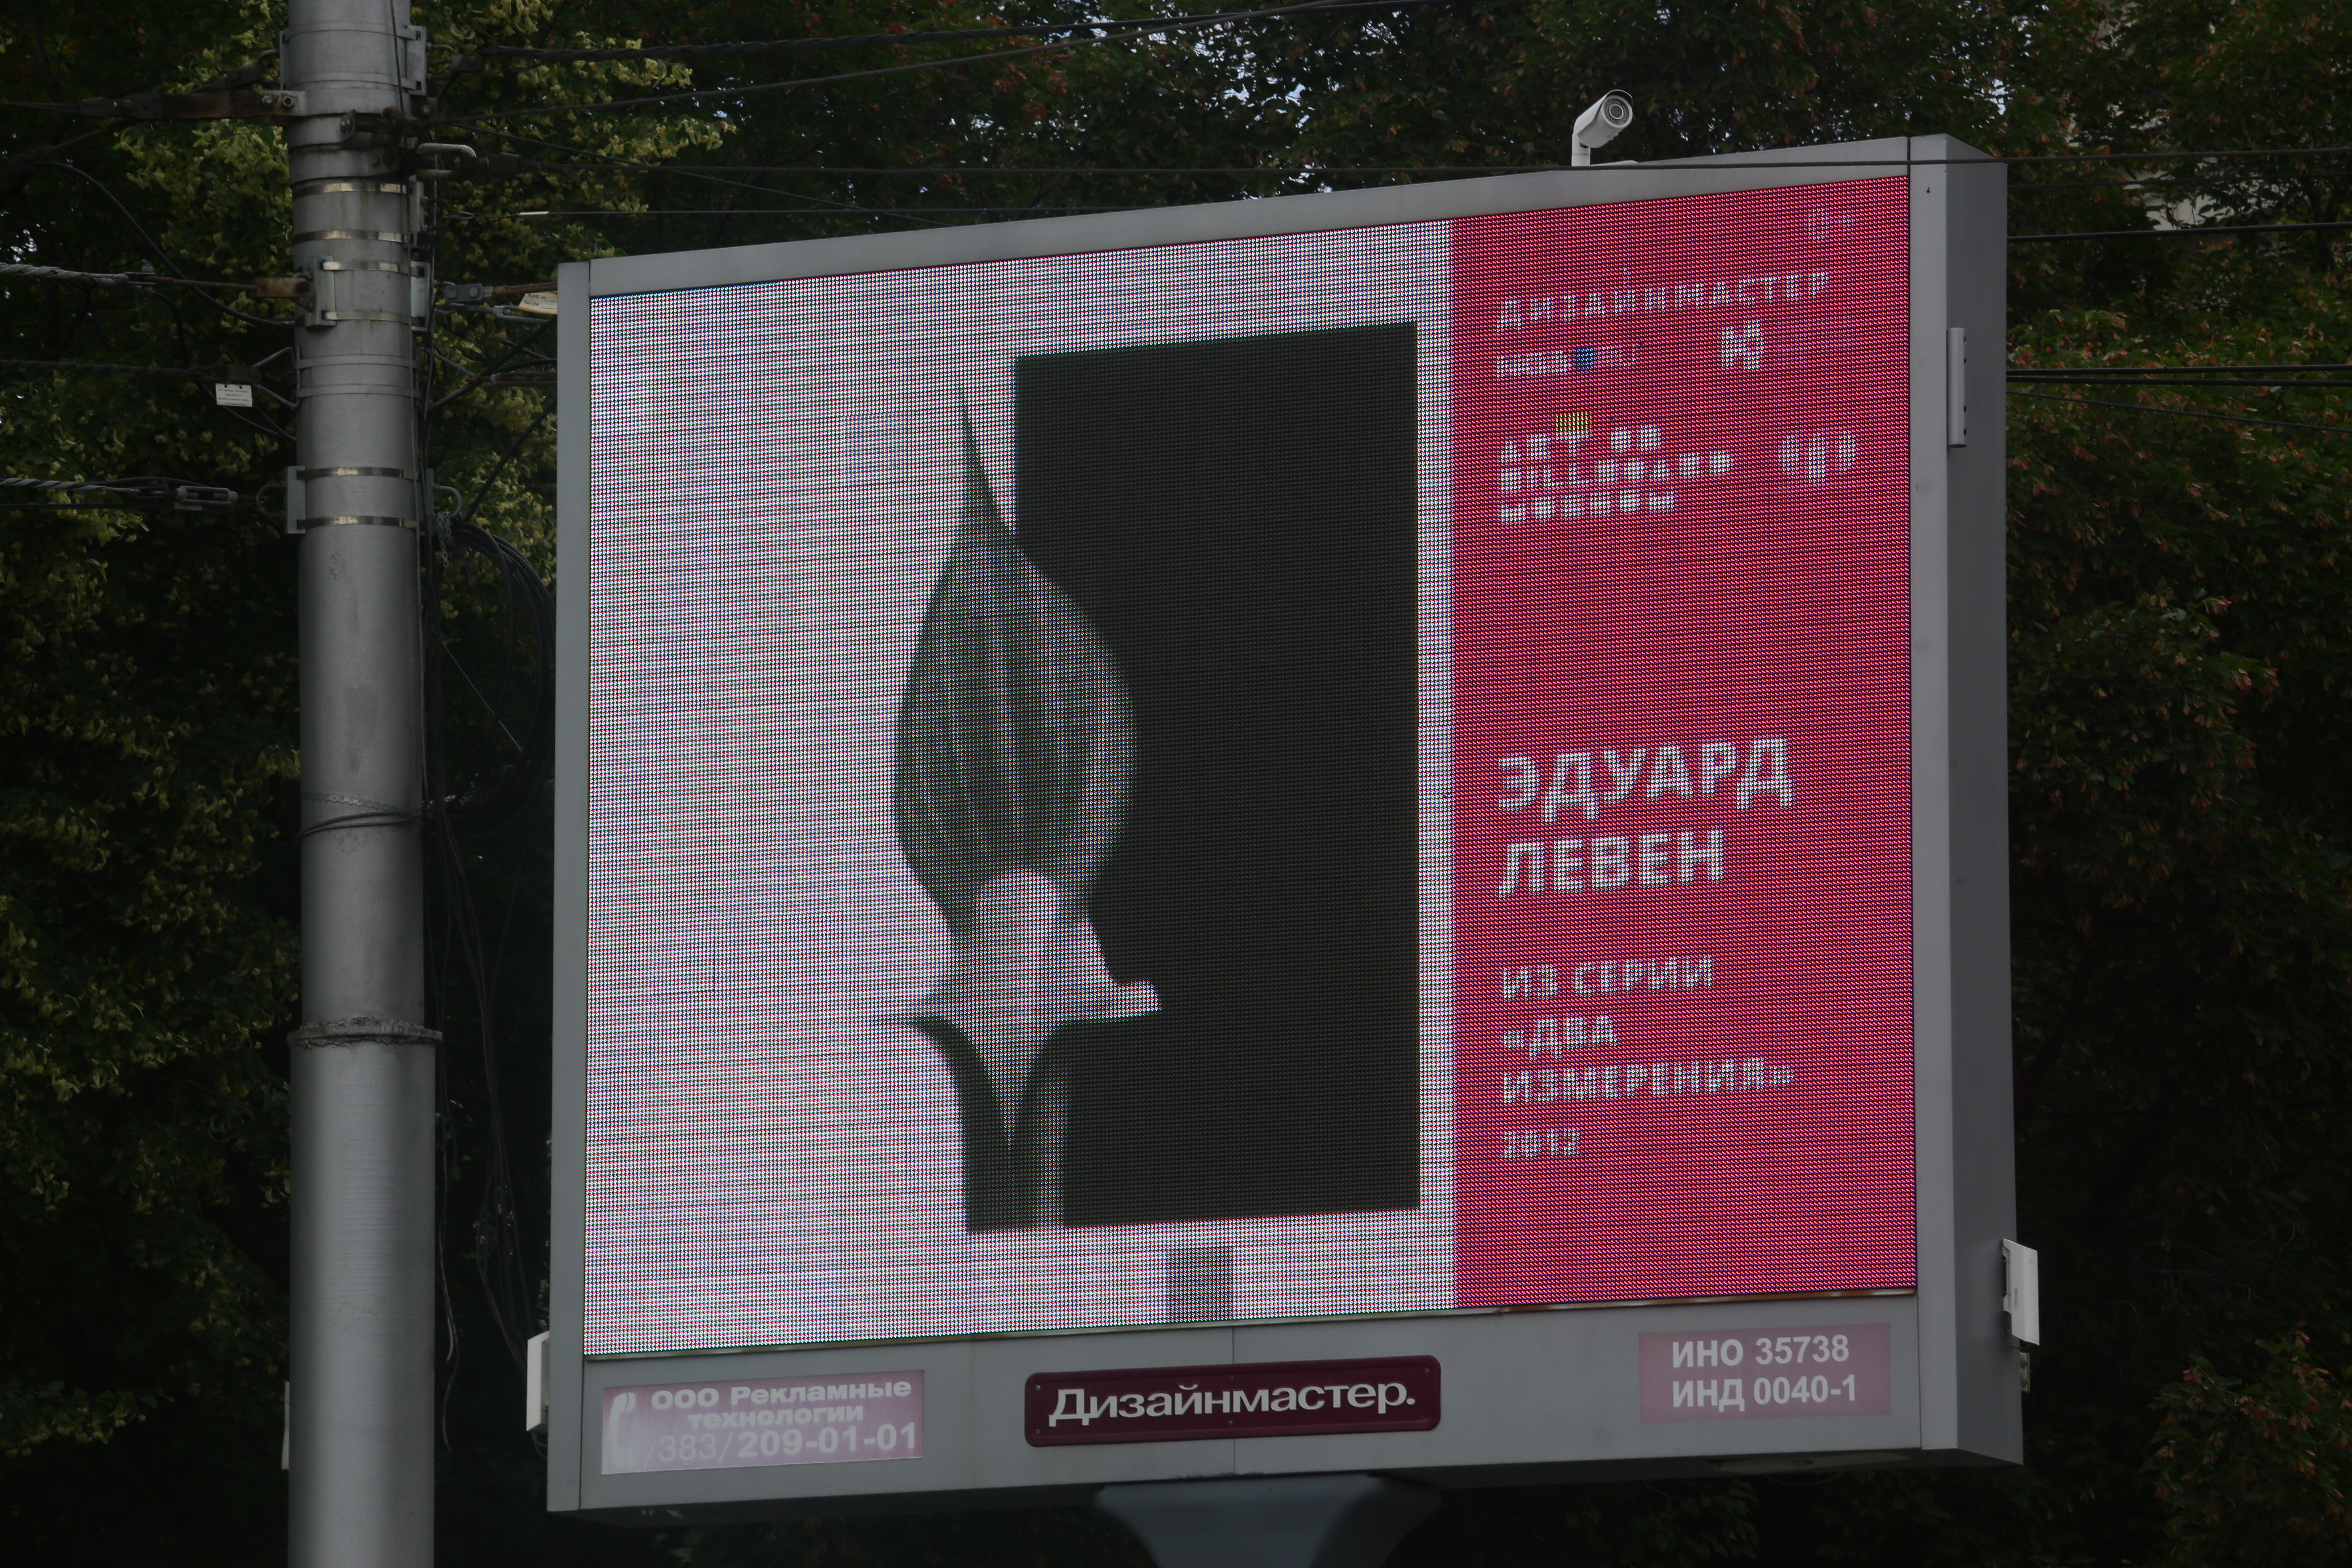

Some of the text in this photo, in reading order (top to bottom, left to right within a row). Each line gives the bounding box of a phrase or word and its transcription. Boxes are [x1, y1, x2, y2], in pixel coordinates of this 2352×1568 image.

[1495, 267, 1829, 332] ДИЗАЙНМАСТЕР
[1497, 737, 1794, 824] ЭДУАРД
[1497, 829, 1724, 898] ЛЕВЕН
[1502, 955, 1713, 1001] ИЗ СЕРИИ
[1502, 1057, 1794, 1105] ИЗМЕРЕНИЯ»
[1672, 1334, 1850, 1368] ИНО 35738
[651, 1381, 912, 1410] ООО Рекламные
[1048, 1381, 1416, 1428] Дизайнмастер.
[1672, 1374, 1856, 1412] ИНД 0040-1
[688, 1403, 864, 1430] технологии
